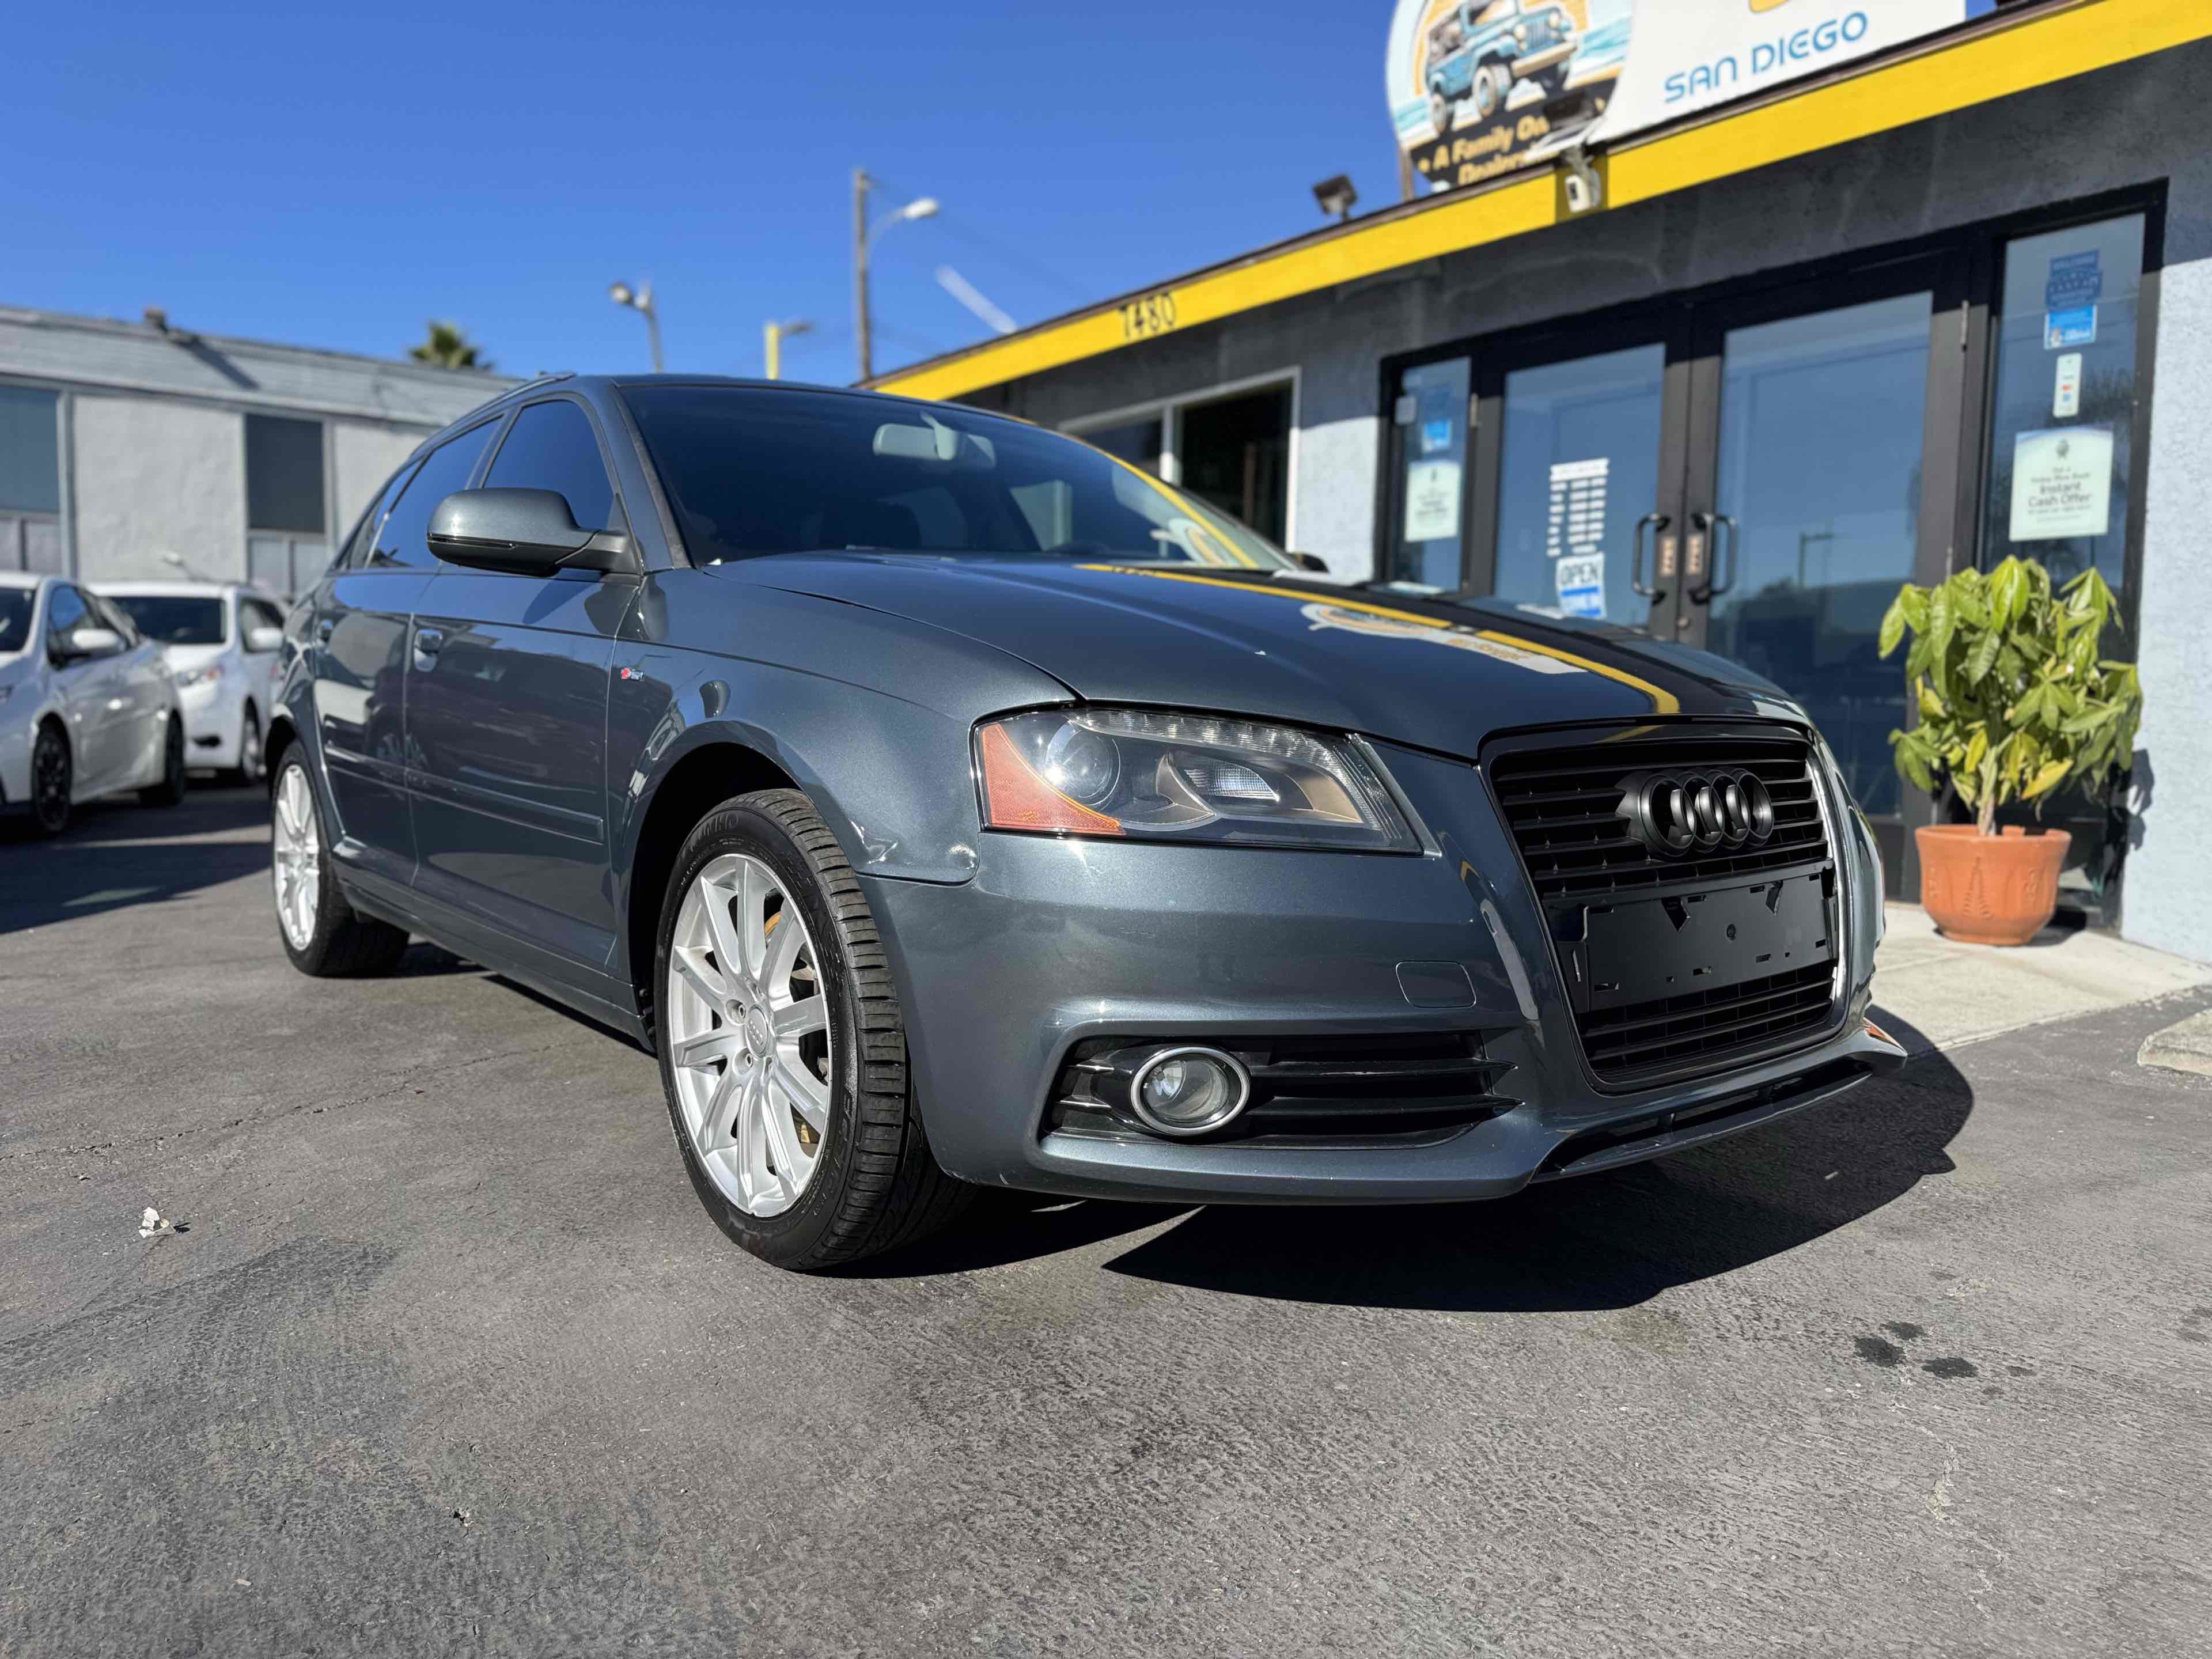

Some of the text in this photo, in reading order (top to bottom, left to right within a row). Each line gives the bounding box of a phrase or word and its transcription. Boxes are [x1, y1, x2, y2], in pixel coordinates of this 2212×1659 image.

[1664, 11, 1868, 103] SAN DIEGO
[1433, 145, 1449, 171] A
[1452, 125, 1514, 163] Family
[2028, 493, 2092, 507] Cash Offer
[2040, 482, 2081, 495] Instant
[1560, 562, 1598, 585] OPEN
